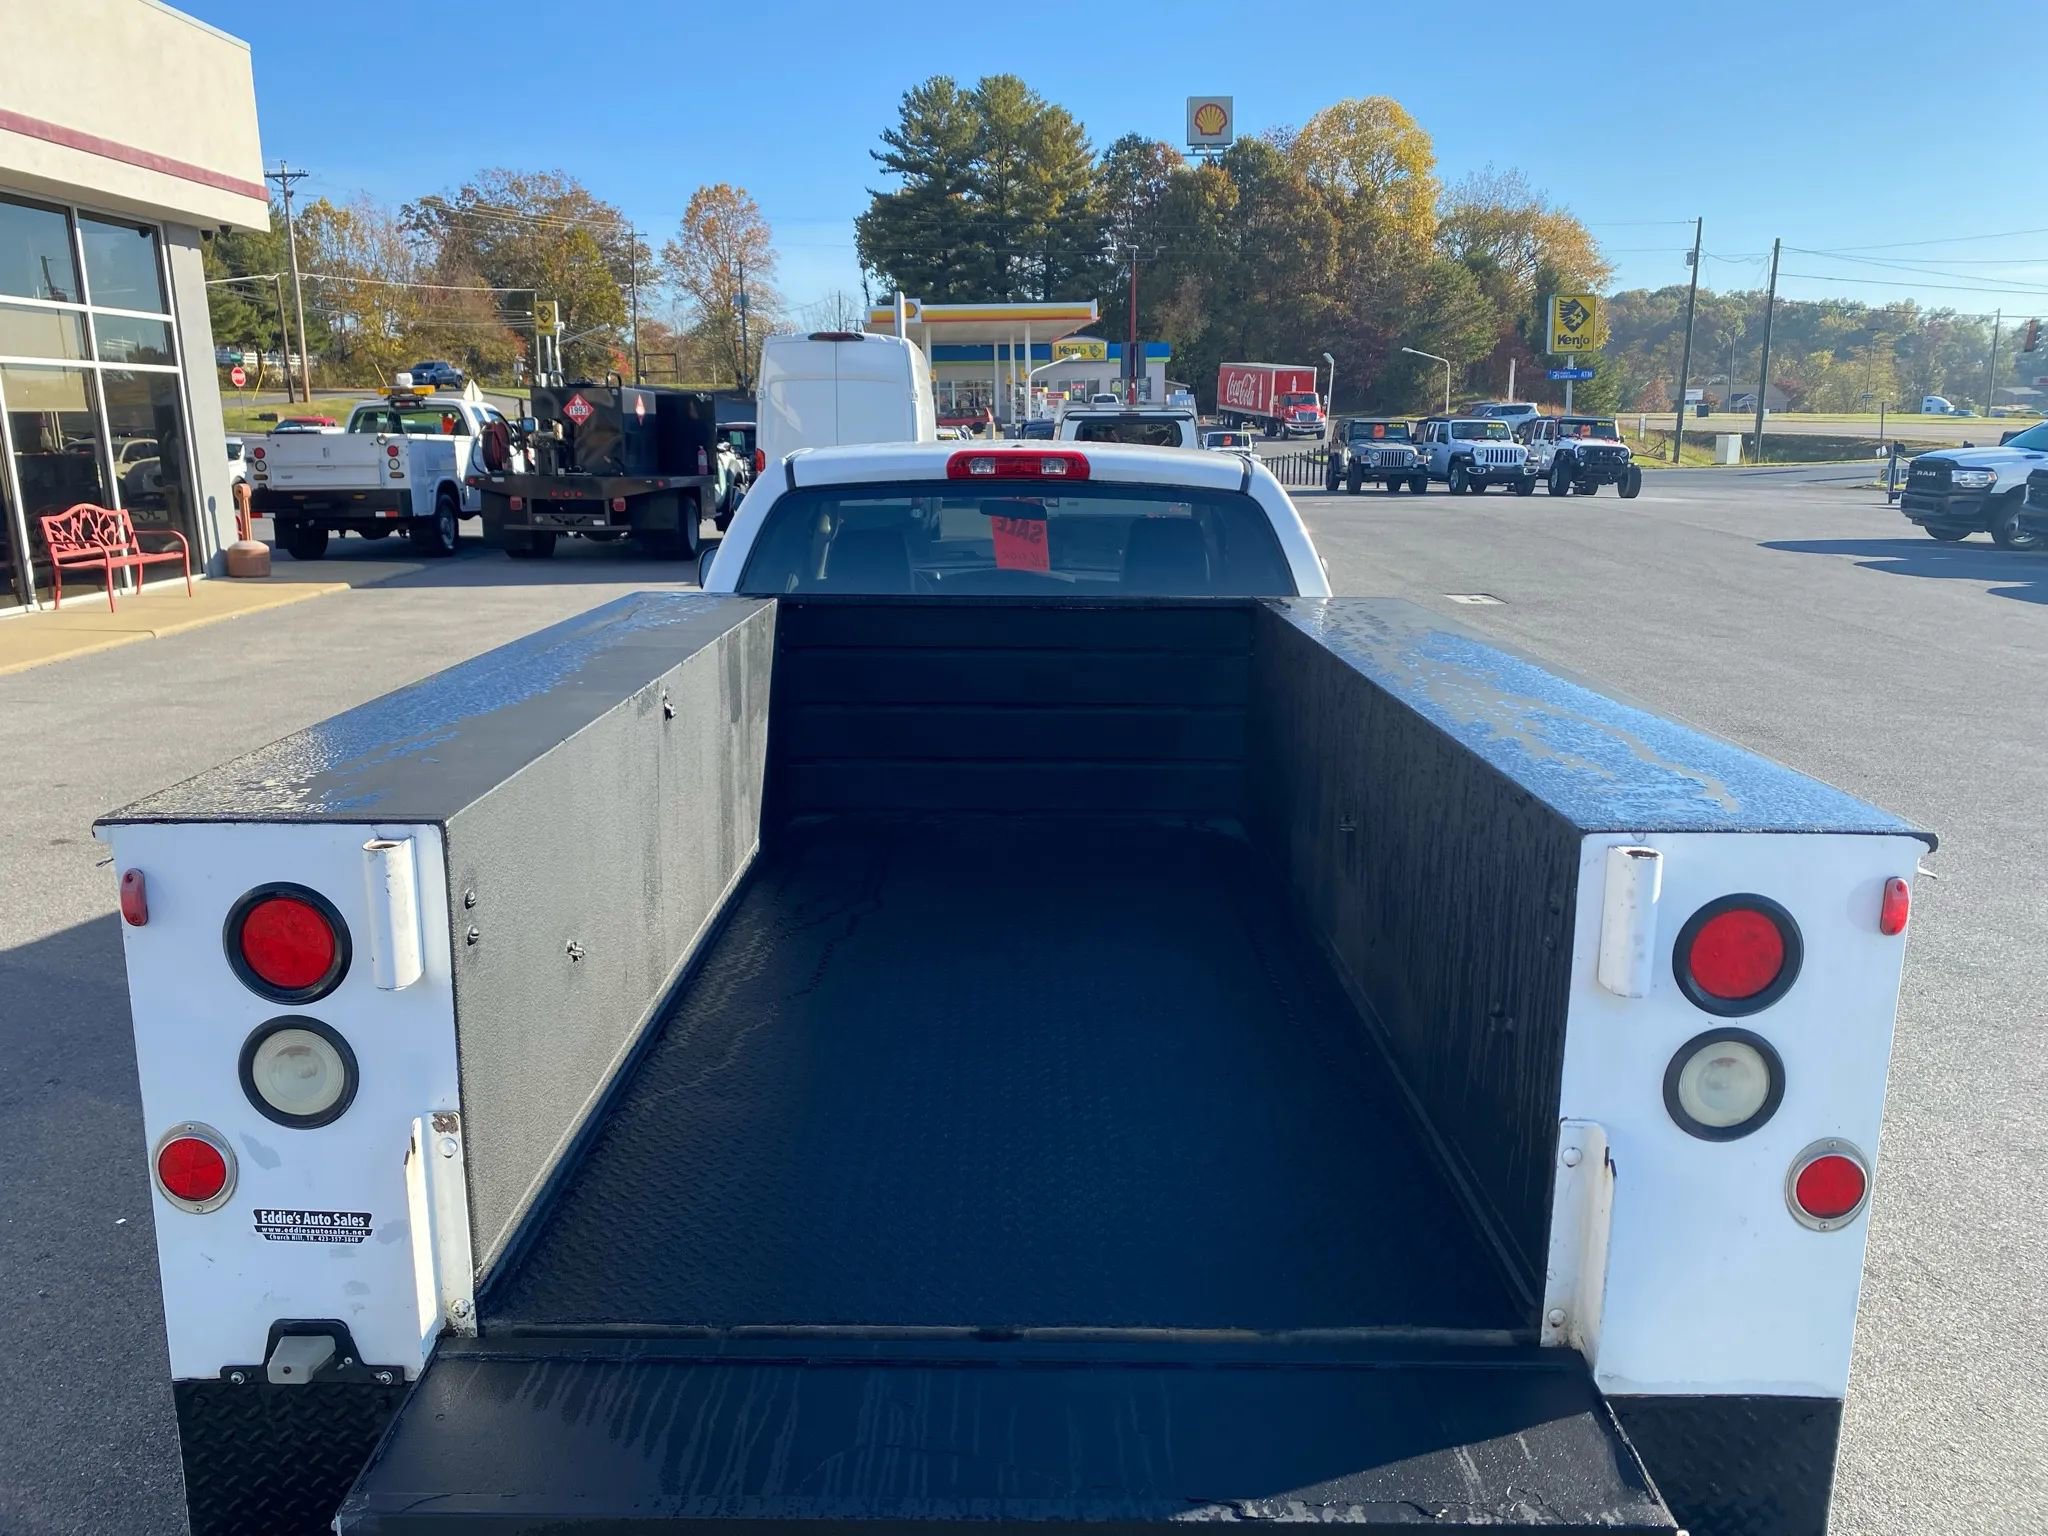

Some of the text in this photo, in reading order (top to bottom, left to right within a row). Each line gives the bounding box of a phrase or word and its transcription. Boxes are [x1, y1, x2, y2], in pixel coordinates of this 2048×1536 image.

[1557, 334, 1590, 349] Kenjo
[261, 1210, 365, 1227] Eddie's Auto Sales
[261, 1227, 366, 1236] www.eddiesautosales.net
